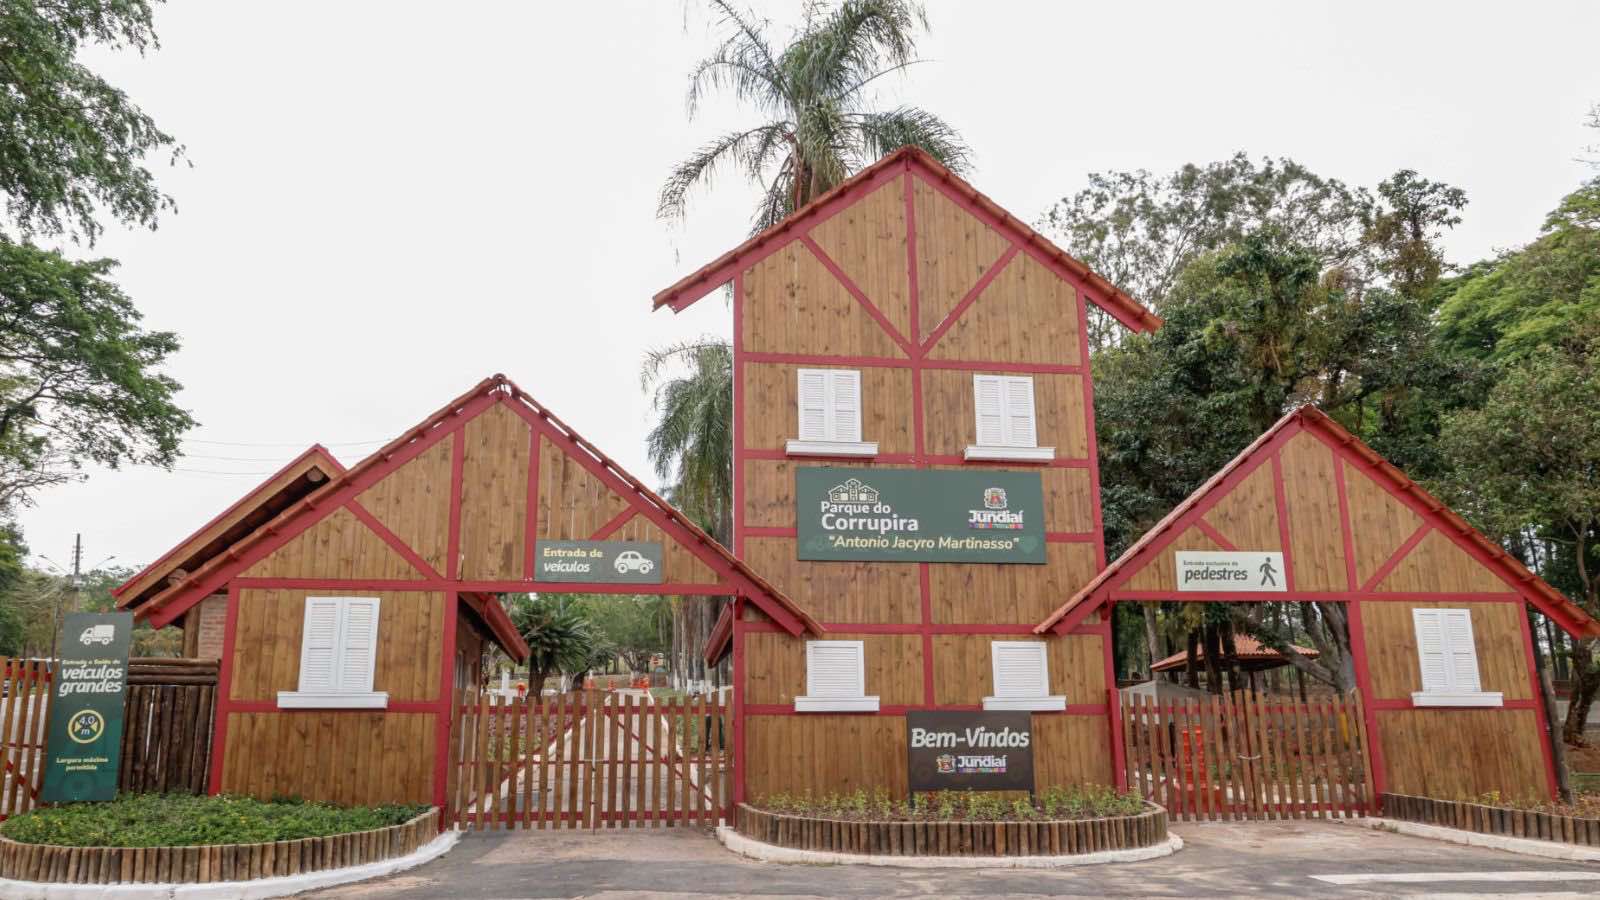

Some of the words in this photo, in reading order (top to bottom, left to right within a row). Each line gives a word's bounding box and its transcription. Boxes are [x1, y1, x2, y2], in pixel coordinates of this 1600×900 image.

[821, 501, 870, 515] Parque
[873, 501, 891, 514] do
[821, 514, 919, 534] Corrupira
[968, 510, 1024, 523] Jundiaí
[829, 535, 889, 549] "Antonio
[891, 536, 935, 551] Jacyro
[939, 536, 1019, 550] Martinasso"
[543, 547, 587, 557] Entrada
[589, 548, 603, 558] de
[543, 560, 590, 573] veículos
[1184, 566, 1248, 584] pedestres
[62, 664, 123, 679] veículos
[58, 679, 122, 696] grandes
[911, 726, 1030, 748] Bem-Vindos
[957, 754, 1008, 768] Jundiaí
